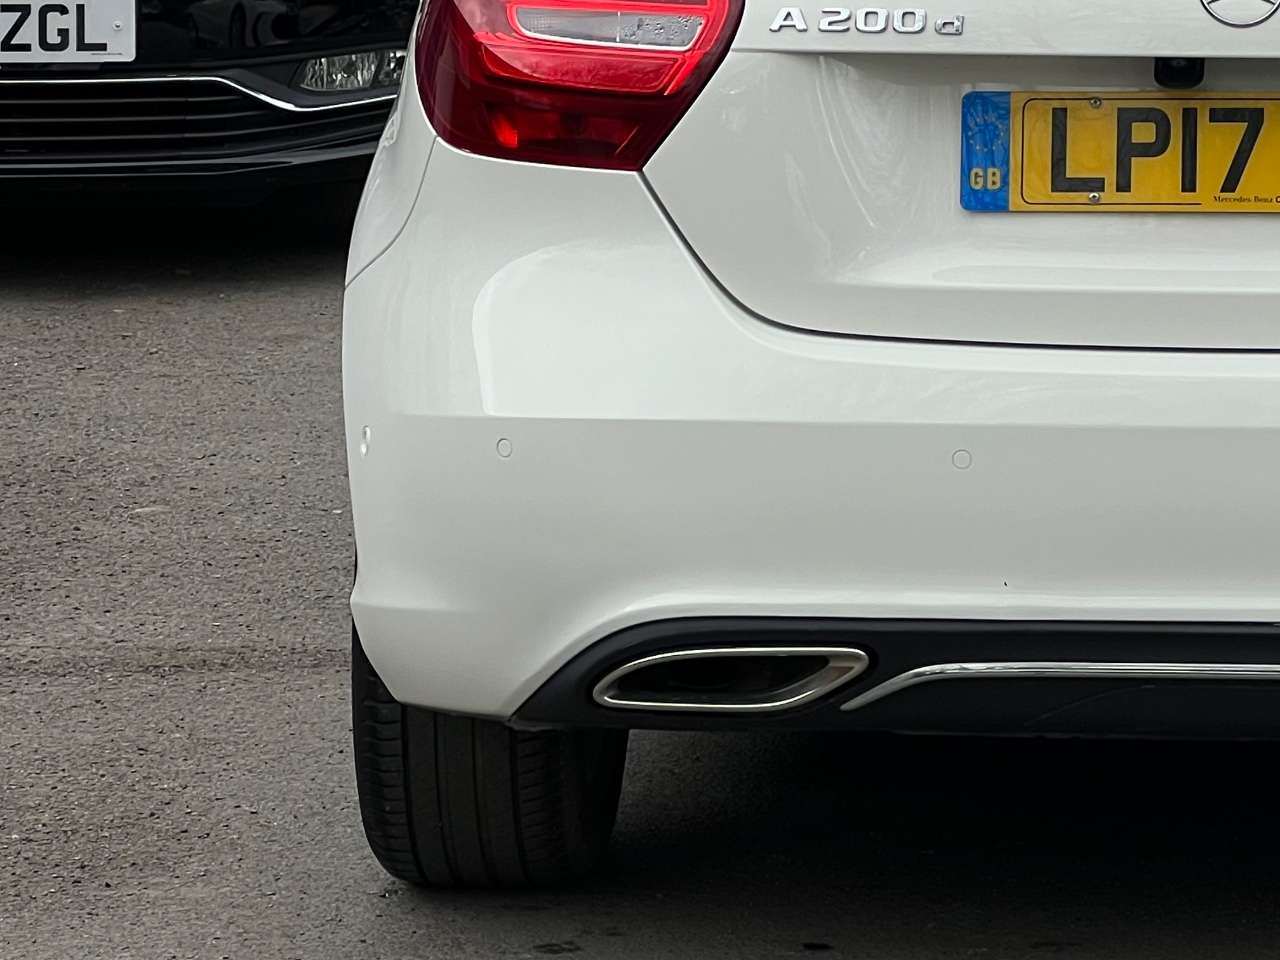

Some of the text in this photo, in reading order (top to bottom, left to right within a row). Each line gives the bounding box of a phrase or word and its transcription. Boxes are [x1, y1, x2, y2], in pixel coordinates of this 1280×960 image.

[0, 3, 108, 52] ZGL
[769, 6, 965, 36] A 200 d
[1050, 106, 1266, 194] LP17
[969, 166, 1002, 191] GB
